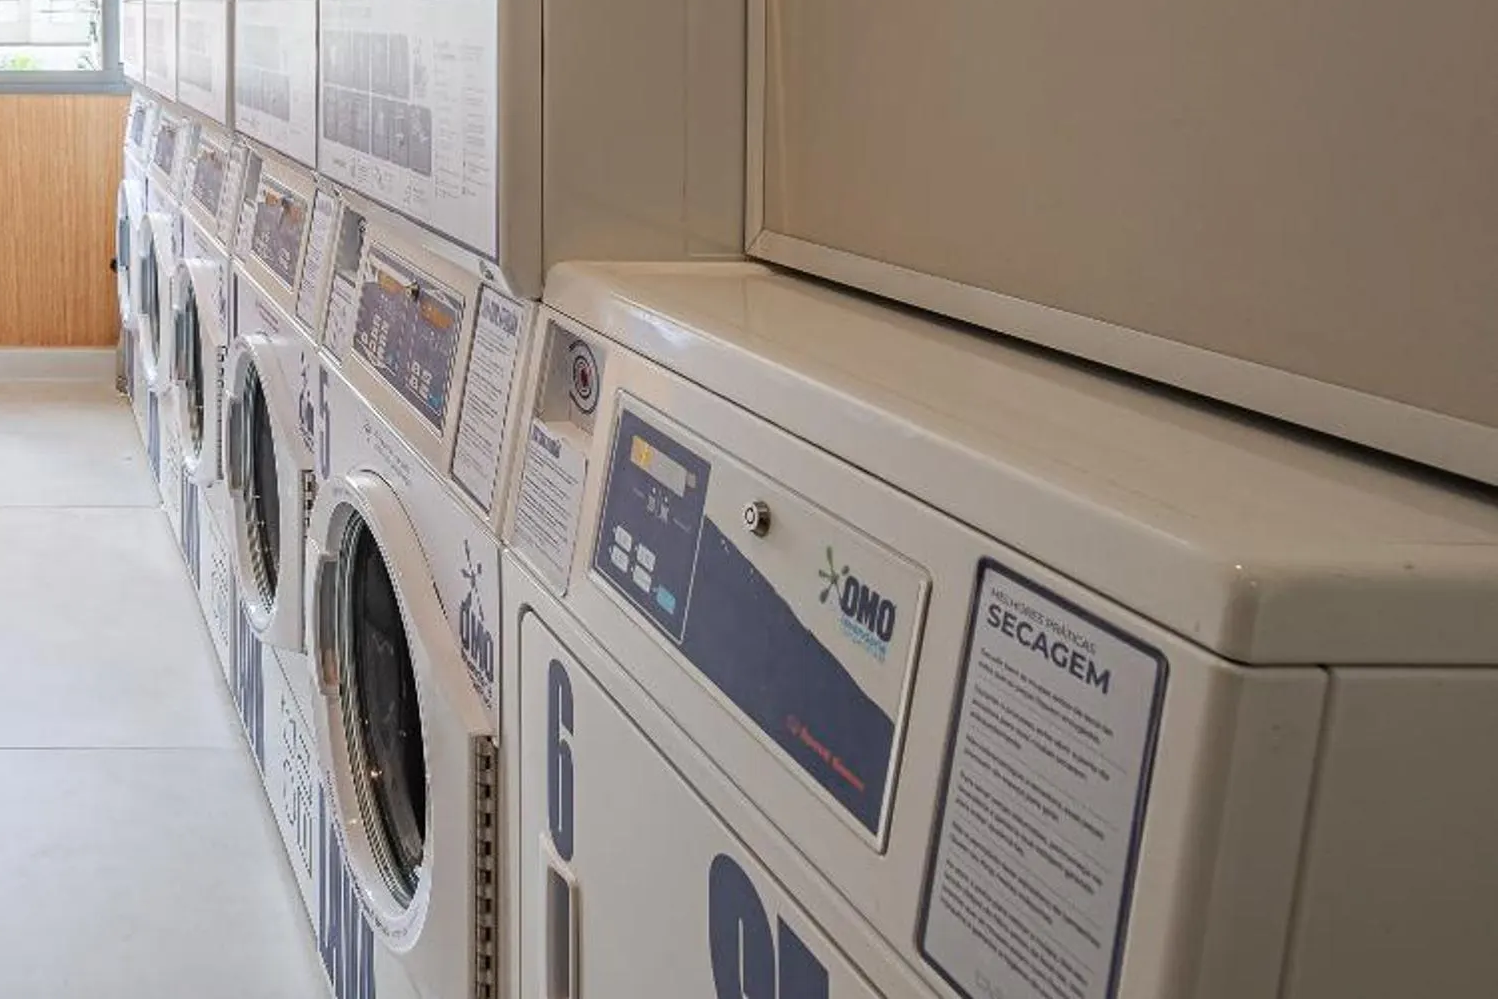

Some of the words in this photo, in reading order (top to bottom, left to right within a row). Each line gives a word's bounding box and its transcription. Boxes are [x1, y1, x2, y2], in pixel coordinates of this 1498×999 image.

[840, 574, 896, 643] OMO
[986, 603, 1112, 695] SECAGEM
[547, 658, 574, 862] 6
